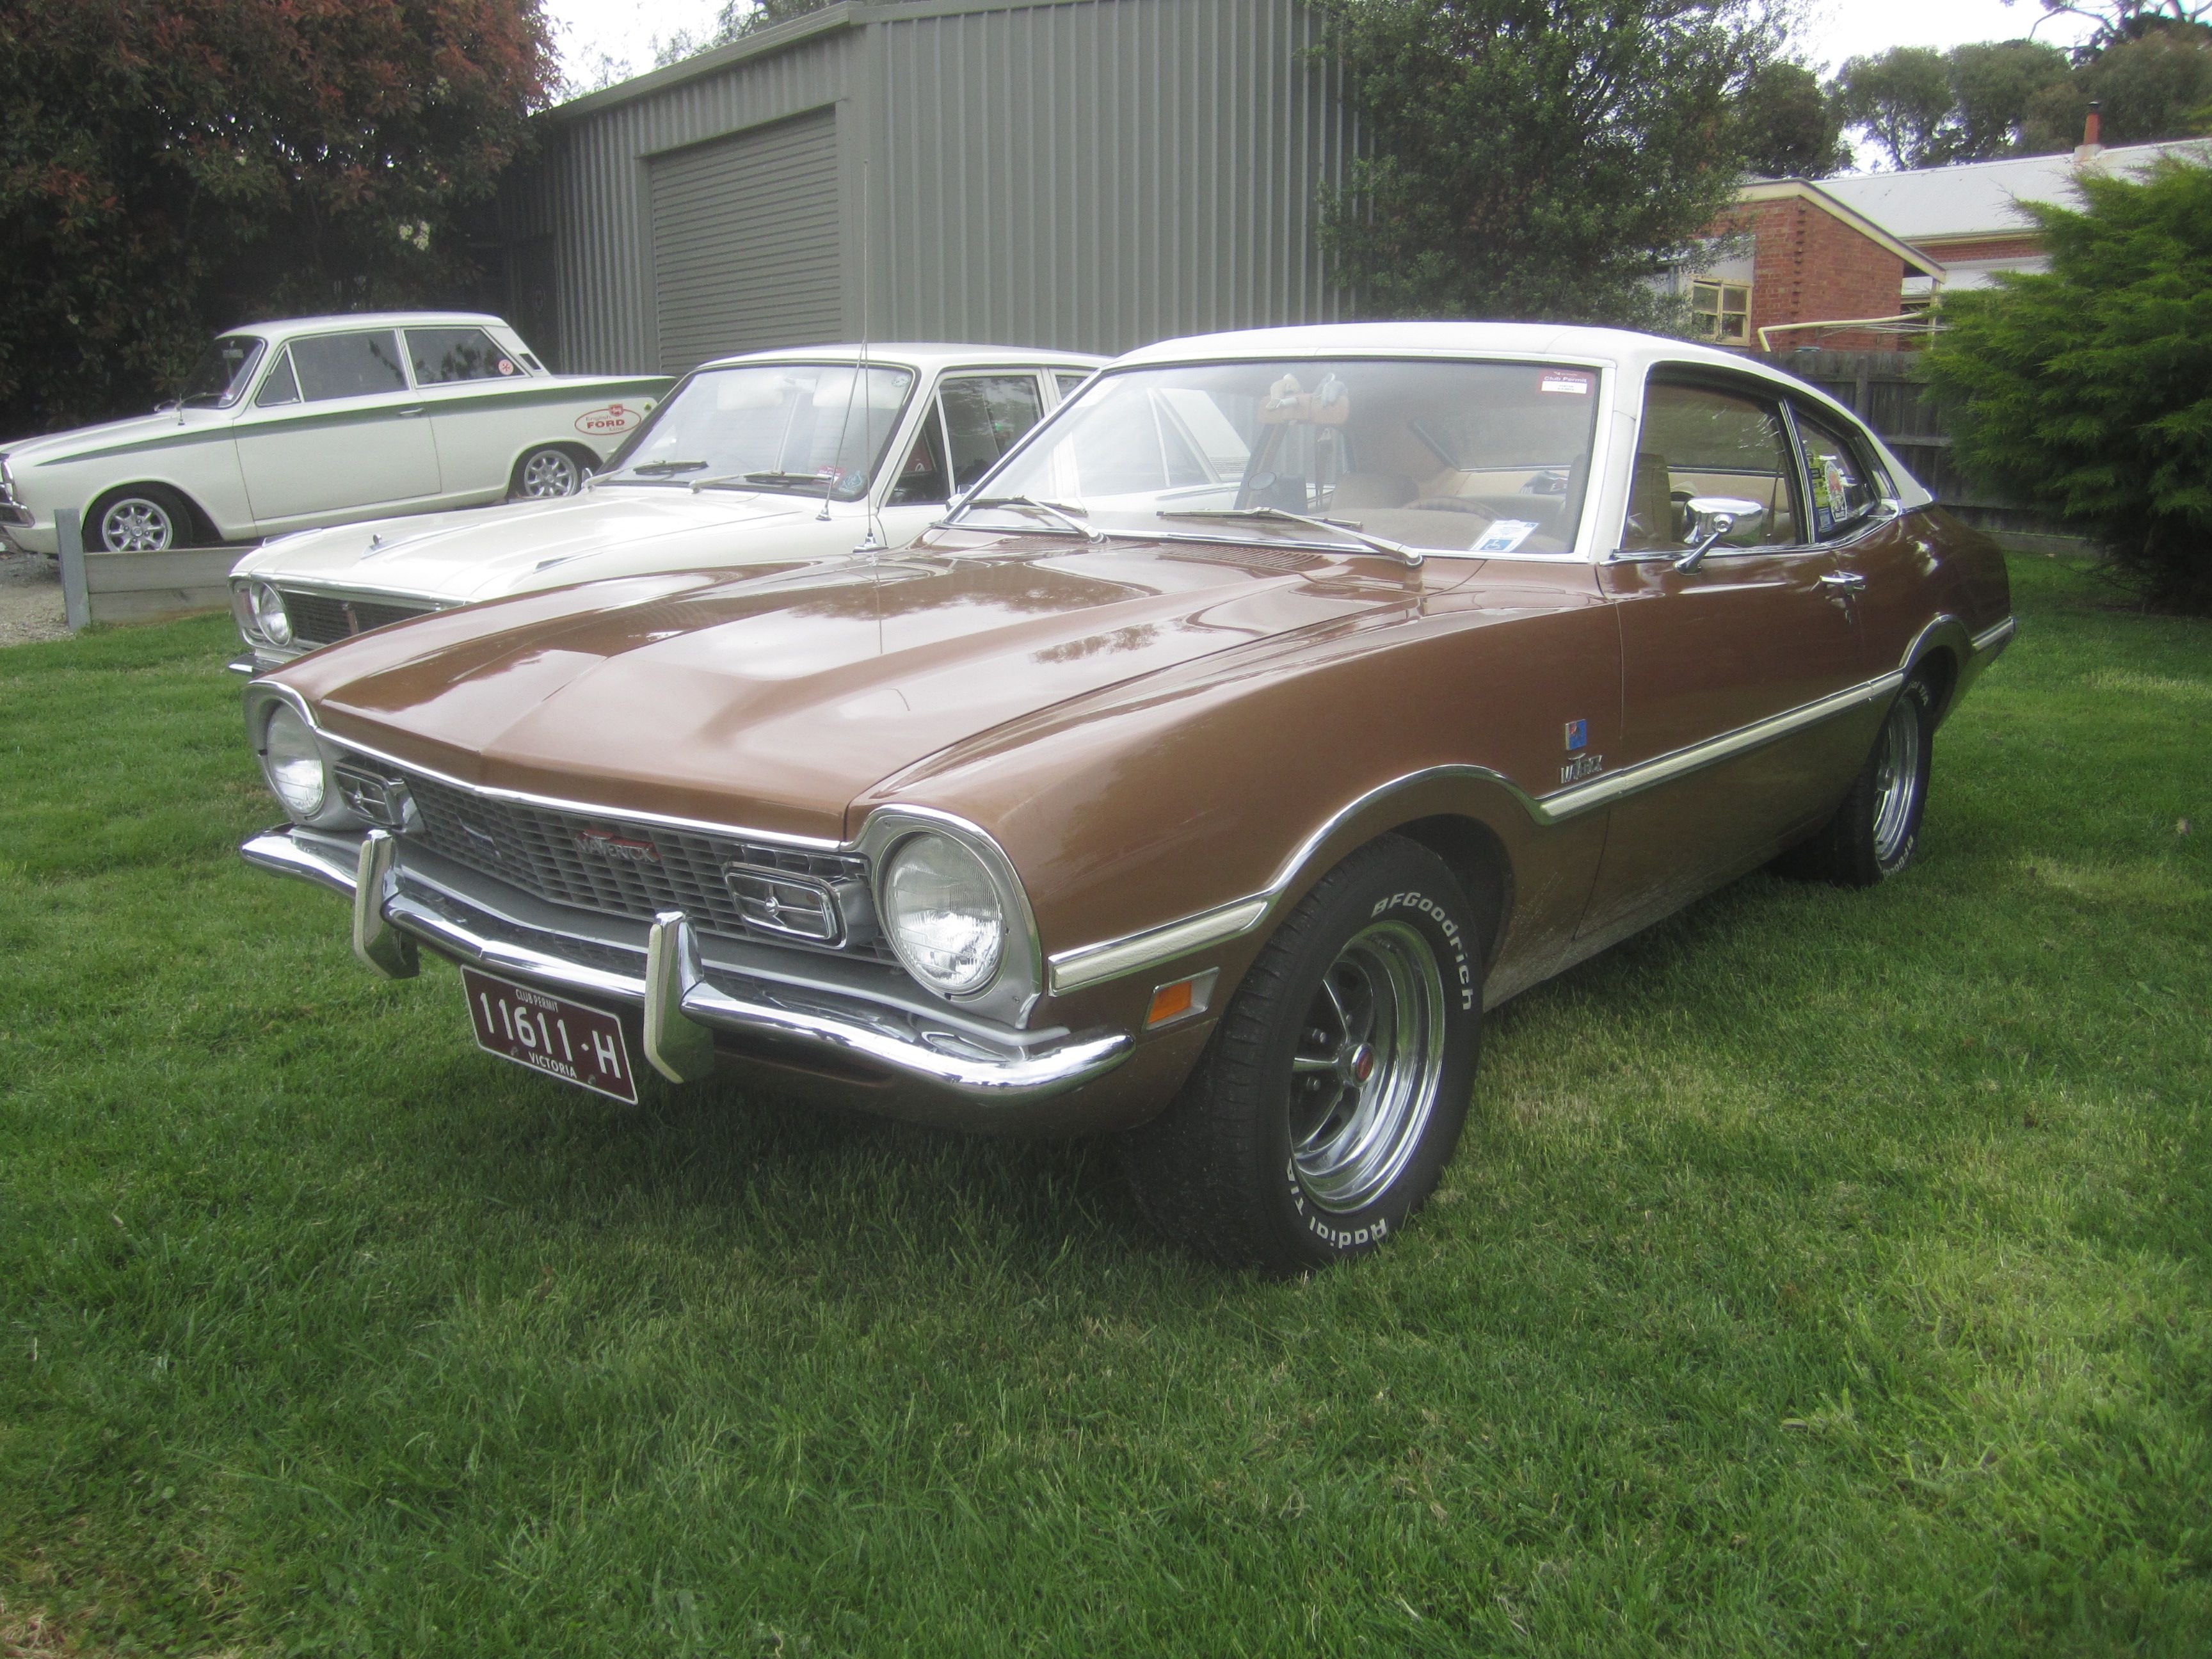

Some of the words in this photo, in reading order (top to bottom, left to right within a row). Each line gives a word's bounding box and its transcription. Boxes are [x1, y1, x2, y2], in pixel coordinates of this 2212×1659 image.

[586, 419, 625, 428] FORD
[1371, 892, 1473, 1010] BFGoodrich
[516, 989, 533, 1004] CLUB
[534, 995, 559, 1013] PERMIT
[528, 1051, 577, 1079] VICTORIA
[1310, 1216, 1387, 1248] Radial
